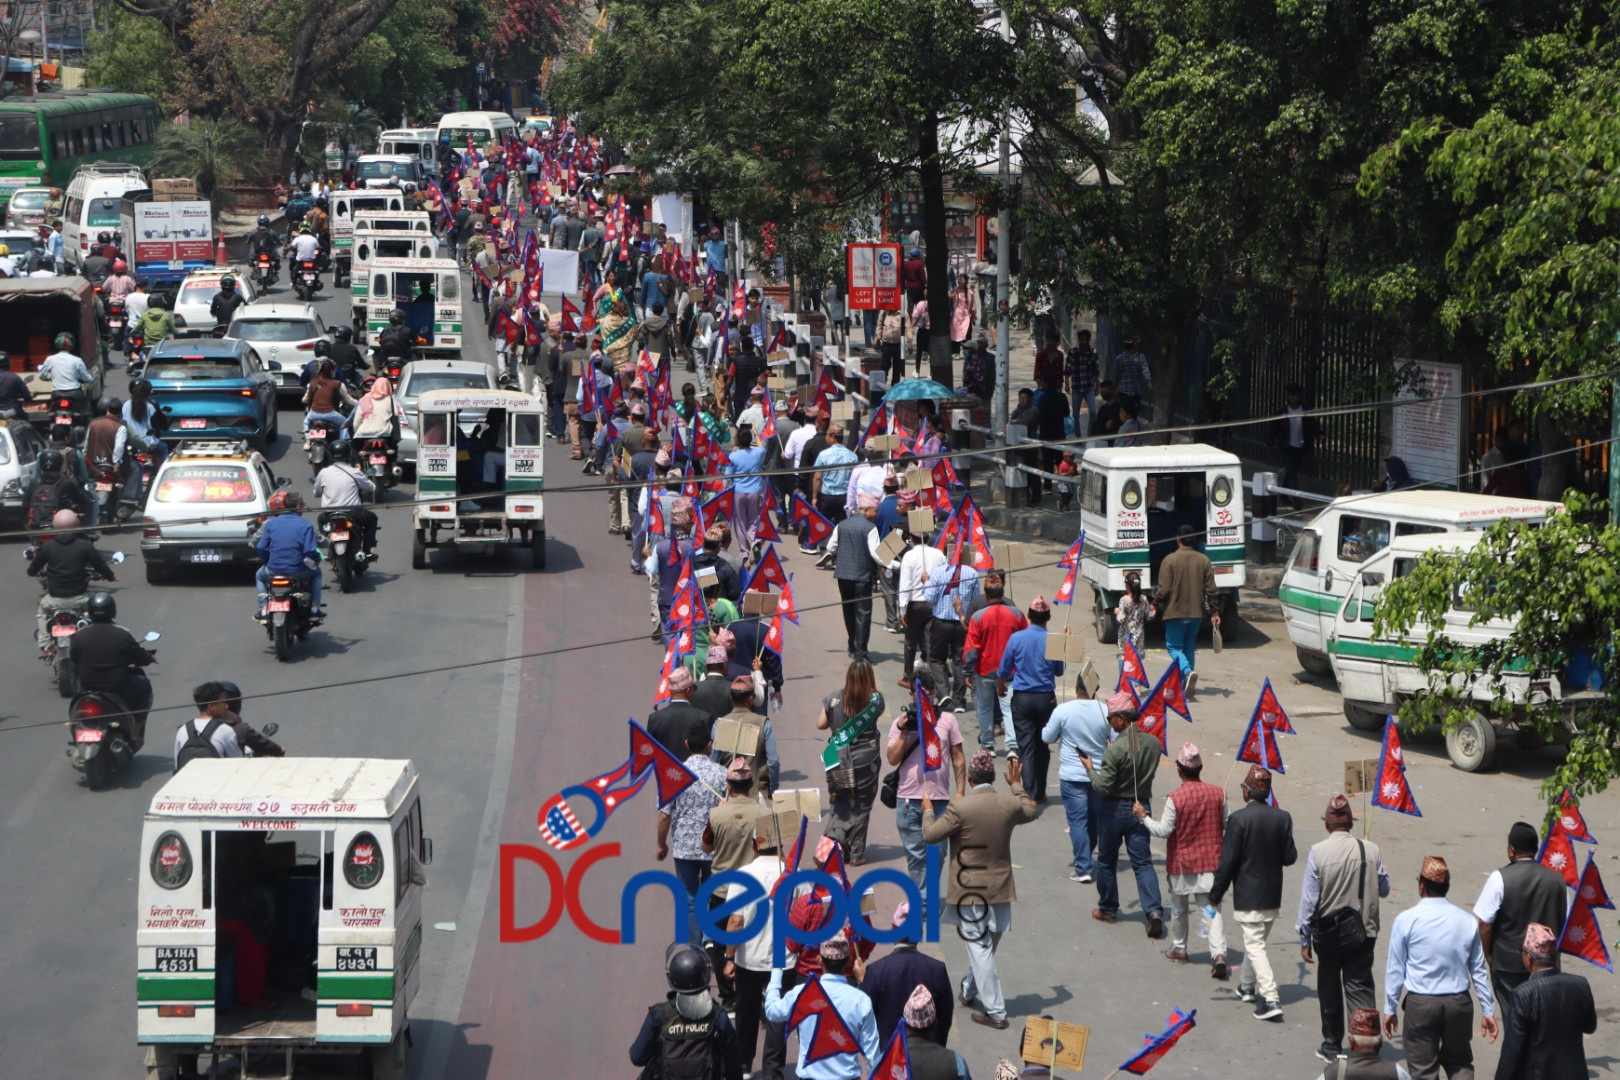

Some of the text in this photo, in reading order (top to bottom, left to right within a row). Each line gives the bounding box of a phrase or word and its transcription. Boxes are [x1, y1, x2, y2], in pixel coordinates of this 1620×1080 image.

[240, 820, 297, 829] WELCOME
[159, 959, 194, 971] 4531
[668, 1023, 684, 1035] CITY
